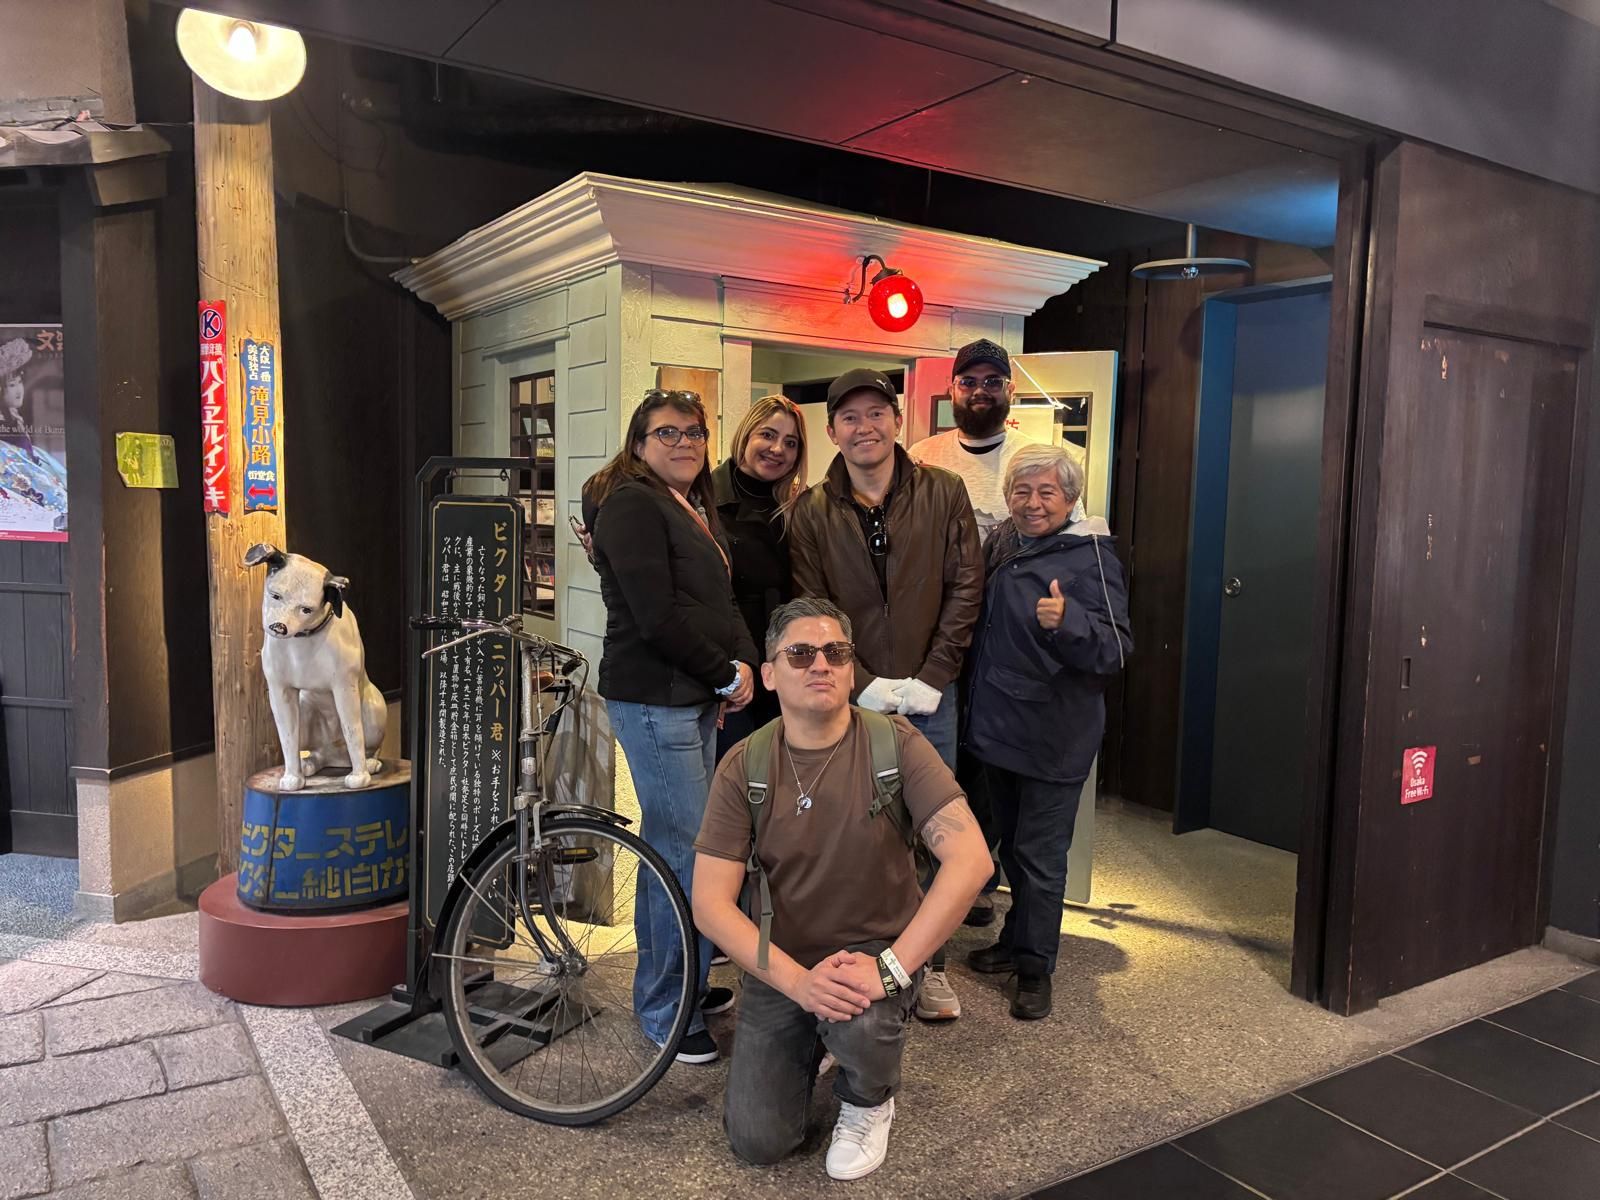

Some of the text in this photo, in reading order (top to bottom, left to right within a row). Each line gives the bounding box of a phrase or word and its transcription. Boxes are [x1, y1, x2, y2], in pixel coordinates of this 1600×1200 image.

[249, 385, 271, 466] 滝見小路
[490, 522, 508, 742] ビクターニッパー君
[488, 749, 503, 831] ※お手をふれ
[1405, 788, 1417, 799] Free
[1410, 776, 1425, 787] Osaka
